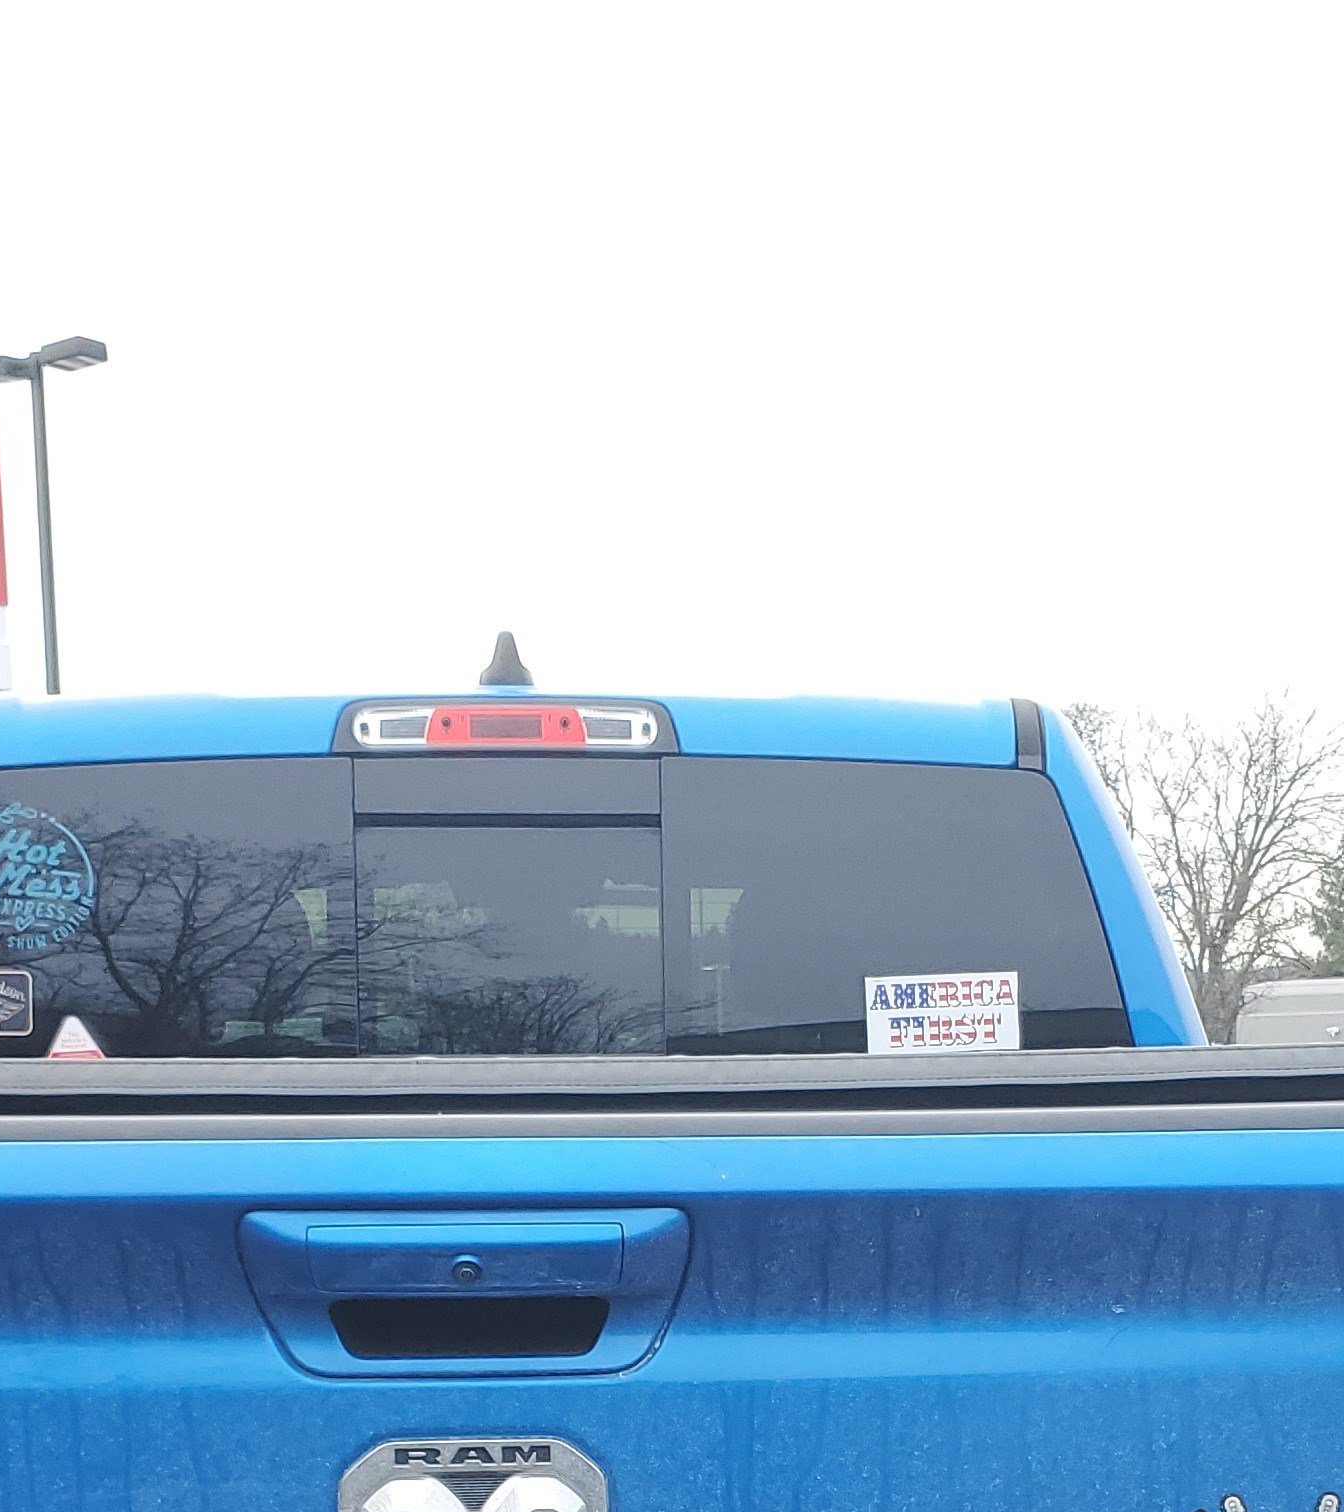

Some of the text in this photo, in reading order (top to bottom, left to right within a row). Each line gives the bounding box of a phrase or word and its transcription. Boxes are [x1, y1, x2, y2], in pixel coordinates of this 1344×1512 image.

[7, 934, 47, 950] SHOW
[51, 894, 94, 943] EDITION
[870, 979, 1015, 1011] AMERICA
[888, 1012, 1002, 1048] FIRST
[393, 1445, 552, 1466] RAM
